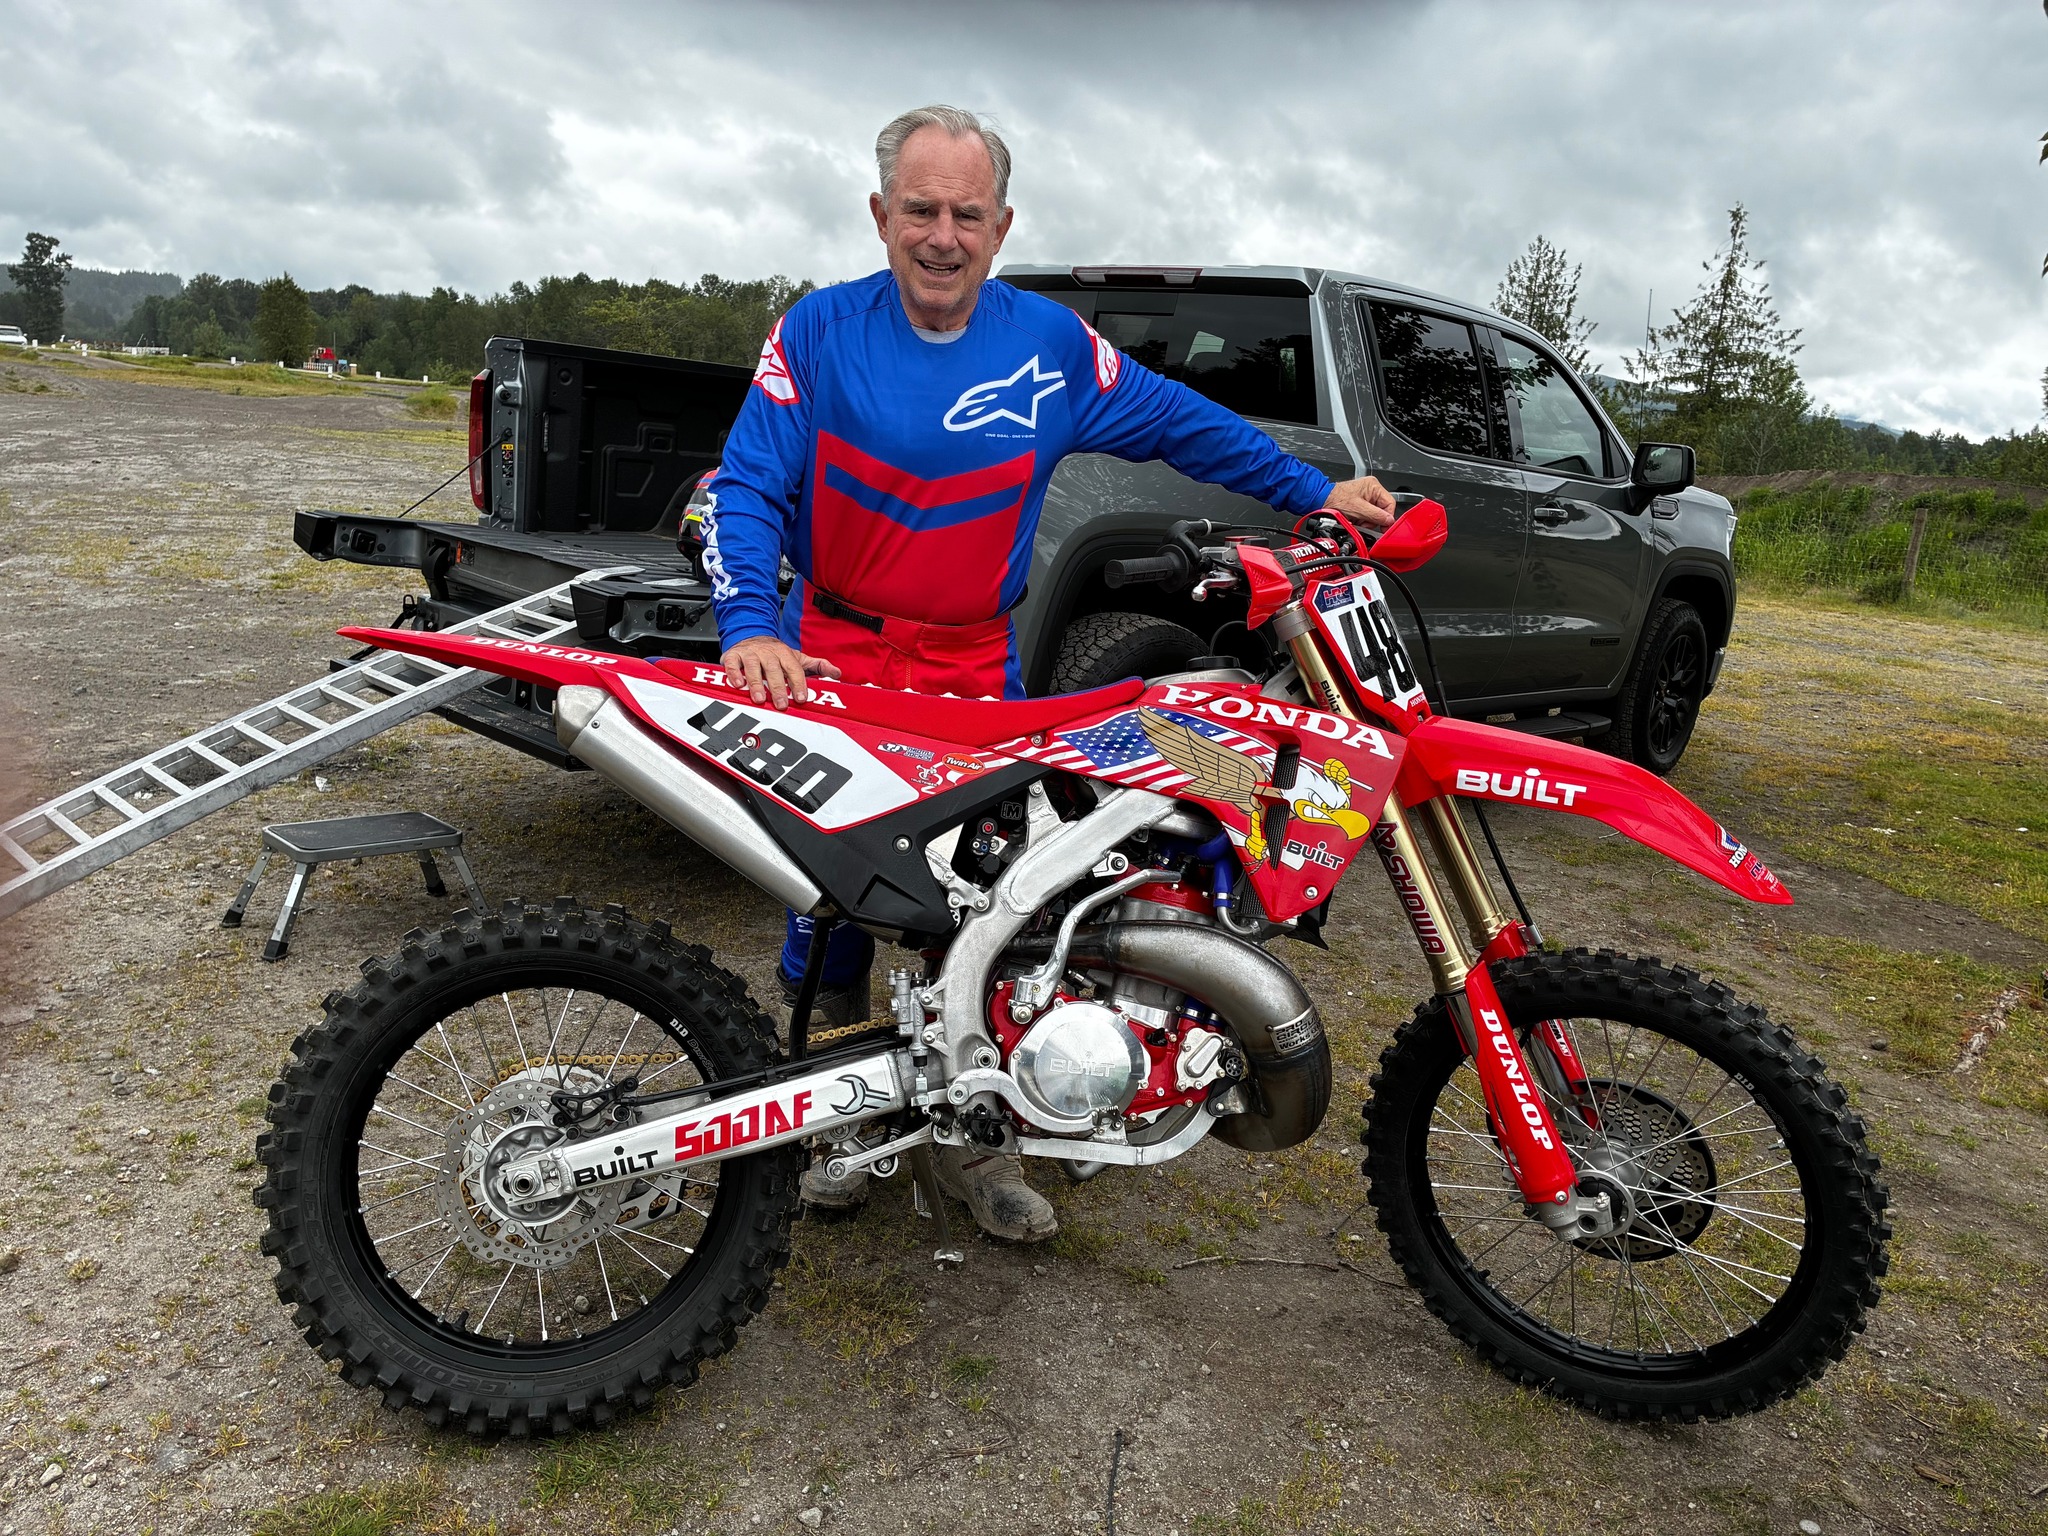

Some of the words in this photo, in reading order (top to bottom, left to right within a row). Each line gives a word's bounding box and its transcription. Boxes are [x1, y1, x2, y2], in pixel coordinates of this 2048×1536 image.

[465, 637, 619, 665] DUNLOP
[1320, 679, 1342, 713] BUILT
[1158, 683, 1394, 760] HONDA
[687, 700, 854, 814] 480
[945, 756, 966, 767] Twin
[966, 761, 983, 771] Air
[1455, 767, 1588, 807] BUILT
[1285, 838, 1345, 870] BUILT
[1382, 854, 1447, 954] SHOWA
[1050, 1053, 1116, 1077] BUILT
[1479, 1008, 1554, 1151] DUNLOP
[572, 1145, 659, 1187] BUILT
